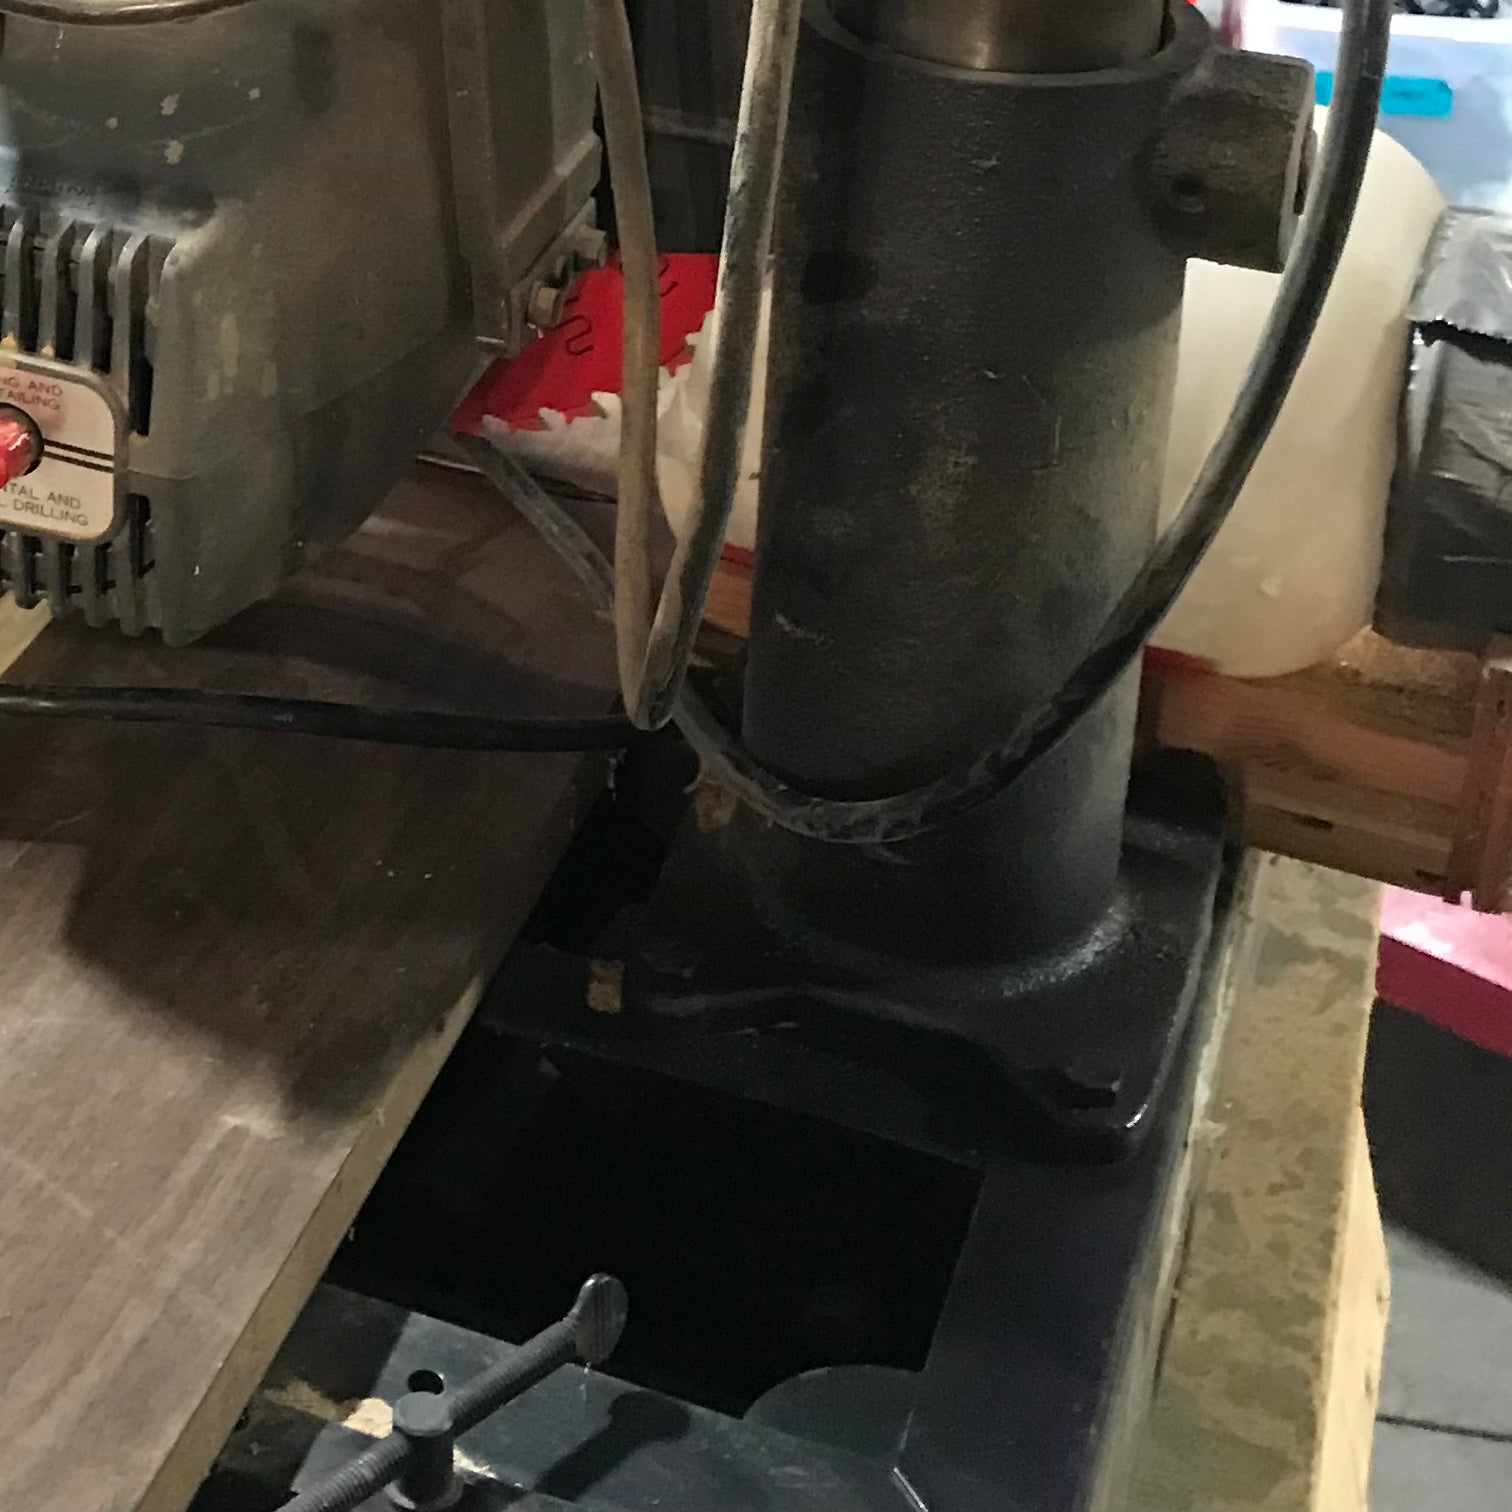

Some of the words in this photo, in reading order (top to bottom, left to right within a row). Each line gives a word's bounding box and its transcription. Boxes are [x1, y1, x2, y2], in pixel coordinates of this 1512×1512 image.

[28, 380, 64, 397] AND
[47, 490, 81, 510] AND
[12, 498, 89, 527] DRILLING
